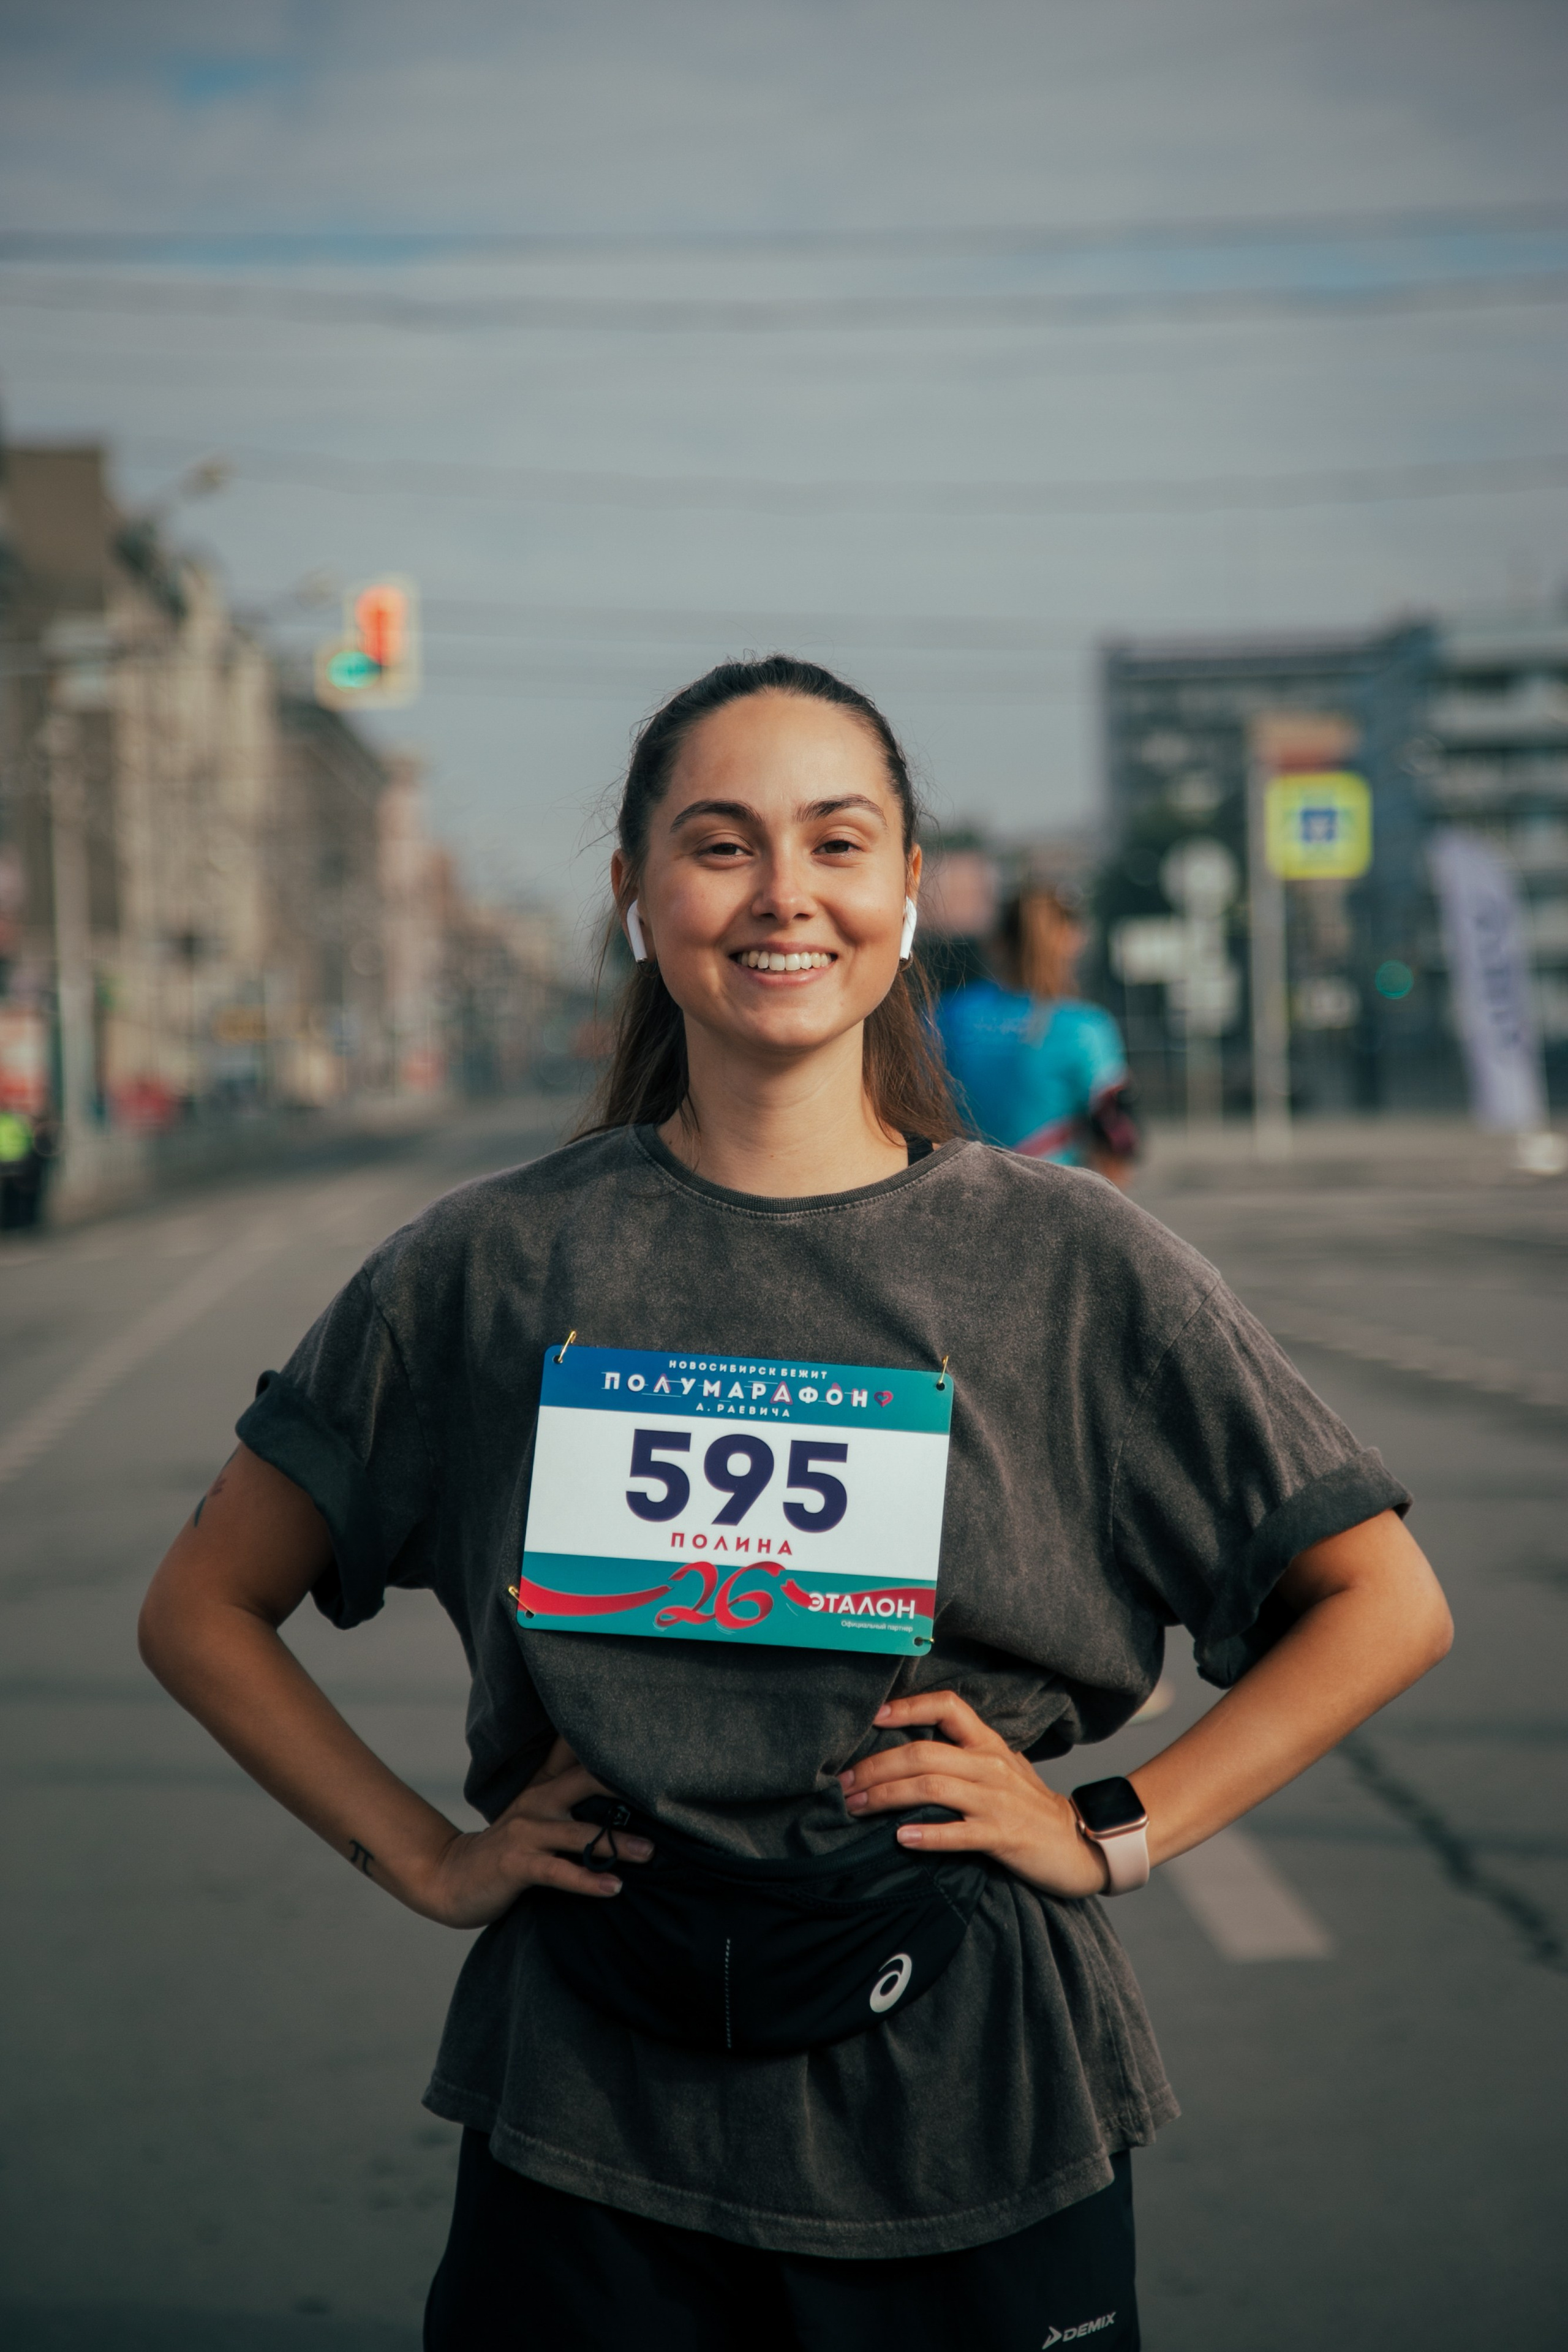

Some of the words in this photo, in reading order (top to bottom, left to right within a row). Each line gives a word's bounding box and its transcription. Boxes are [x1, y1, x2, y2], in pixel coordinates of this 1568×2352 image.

[669, 1360, 775, 1375] НОВОСИБИРСК
[780, 1368, 827, 1379] БЕЖИТ
[604, 1371, 869, 1408] ПОЛУМАРАФОН
[696, 1402, 710, 1411] А.
[717, 1403, 790, 1417] РАЕВИЧА
[625, 1428, 849, 1534] 595
[670, 1532, 793, 1556] ПОЛИНА
[654, 1561, 786, 1630] 26
[807, 1592, 916, 1619] ЭТАЛОН
[840, 1619, 886, 1630] Официальный
[1062, 2311, 1117, 2342] DEMIX
